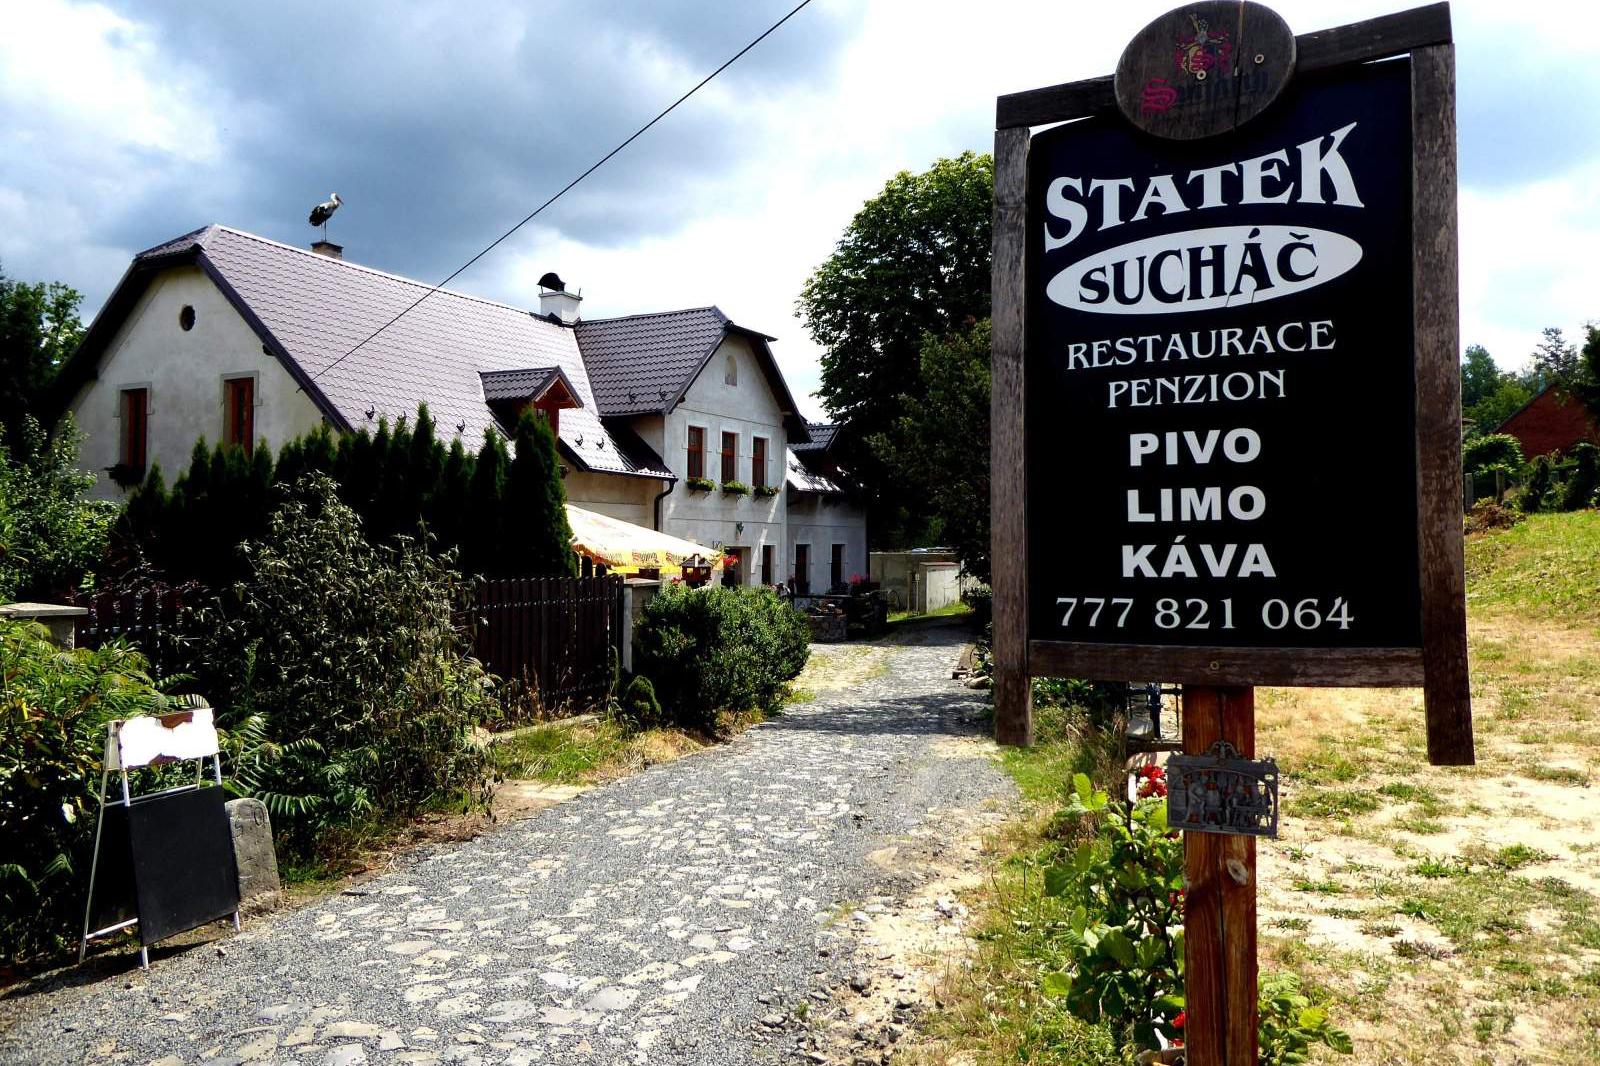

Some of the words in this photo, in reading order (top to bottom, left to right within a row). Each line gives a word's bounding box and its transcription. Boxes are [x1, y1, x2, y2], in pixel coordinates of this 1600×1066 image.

[1044, 121, 1365, 254] STATEK
[1079, 227, 1319, 306] SUCHÁČ
[1067, 319, 1336, 370] RESTAURACE
[1108, 369, 1286, 408] PENZION
[1129, 427, 1262, 467] PIVO
[1127, 485, 1266, 523] LIMO
[1121, 535, 1277, 579] KÁVA
[1056, 597, 1134, 628] 777
[1154, 598, 1236, 629] 821
[1261, 596, 1355, 630] 064
